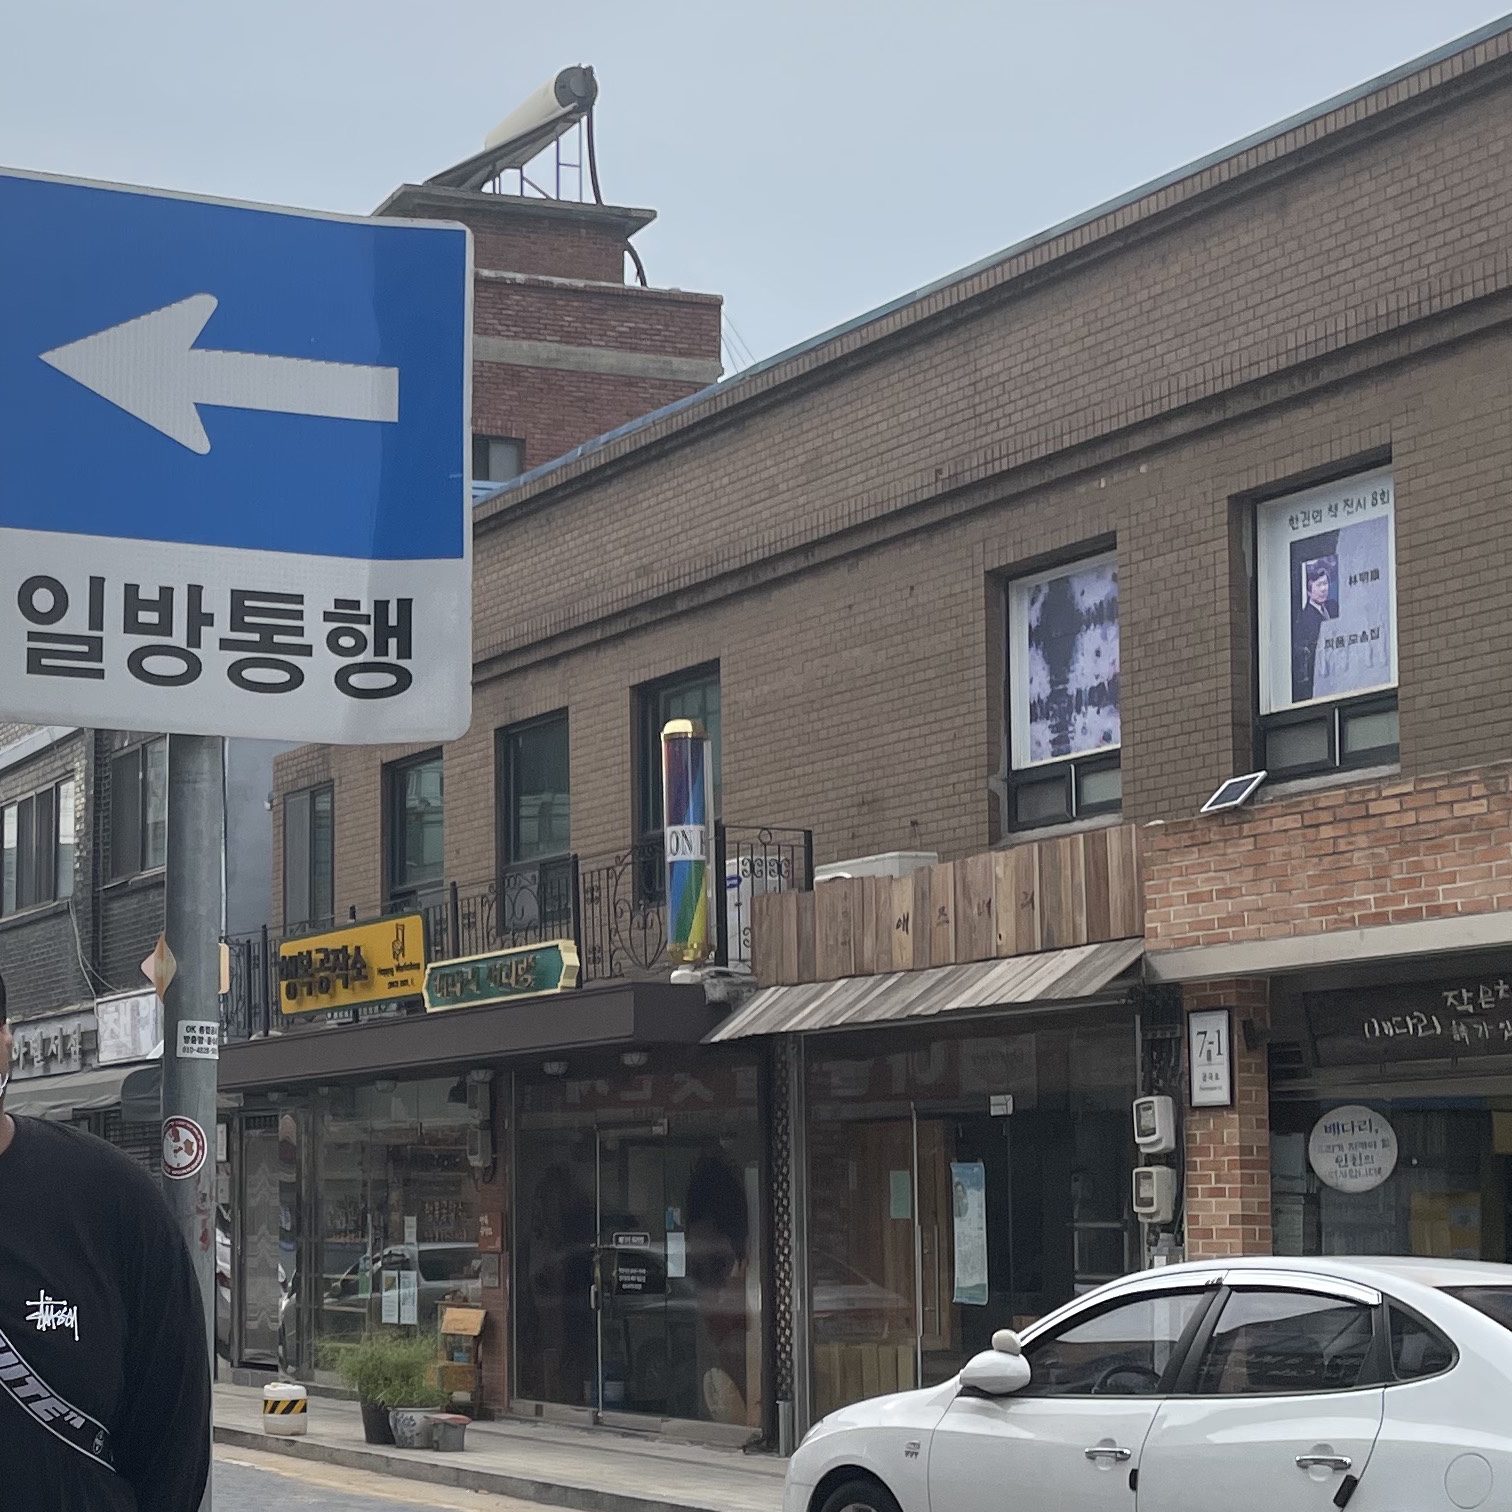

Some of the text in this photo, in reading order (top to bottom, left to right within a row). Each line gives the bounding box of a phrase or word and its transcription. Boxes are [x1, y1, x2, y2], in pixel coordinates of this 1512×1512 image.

[1371, 488, 1390, 507] 8회
[16, 574, 414, 700] 일방통행
[185, 1025, 196, 1033] OK
[1196, 1029, 1223, 1057] 7-1
[11, 1022, 82, 1070] 아벨서점
